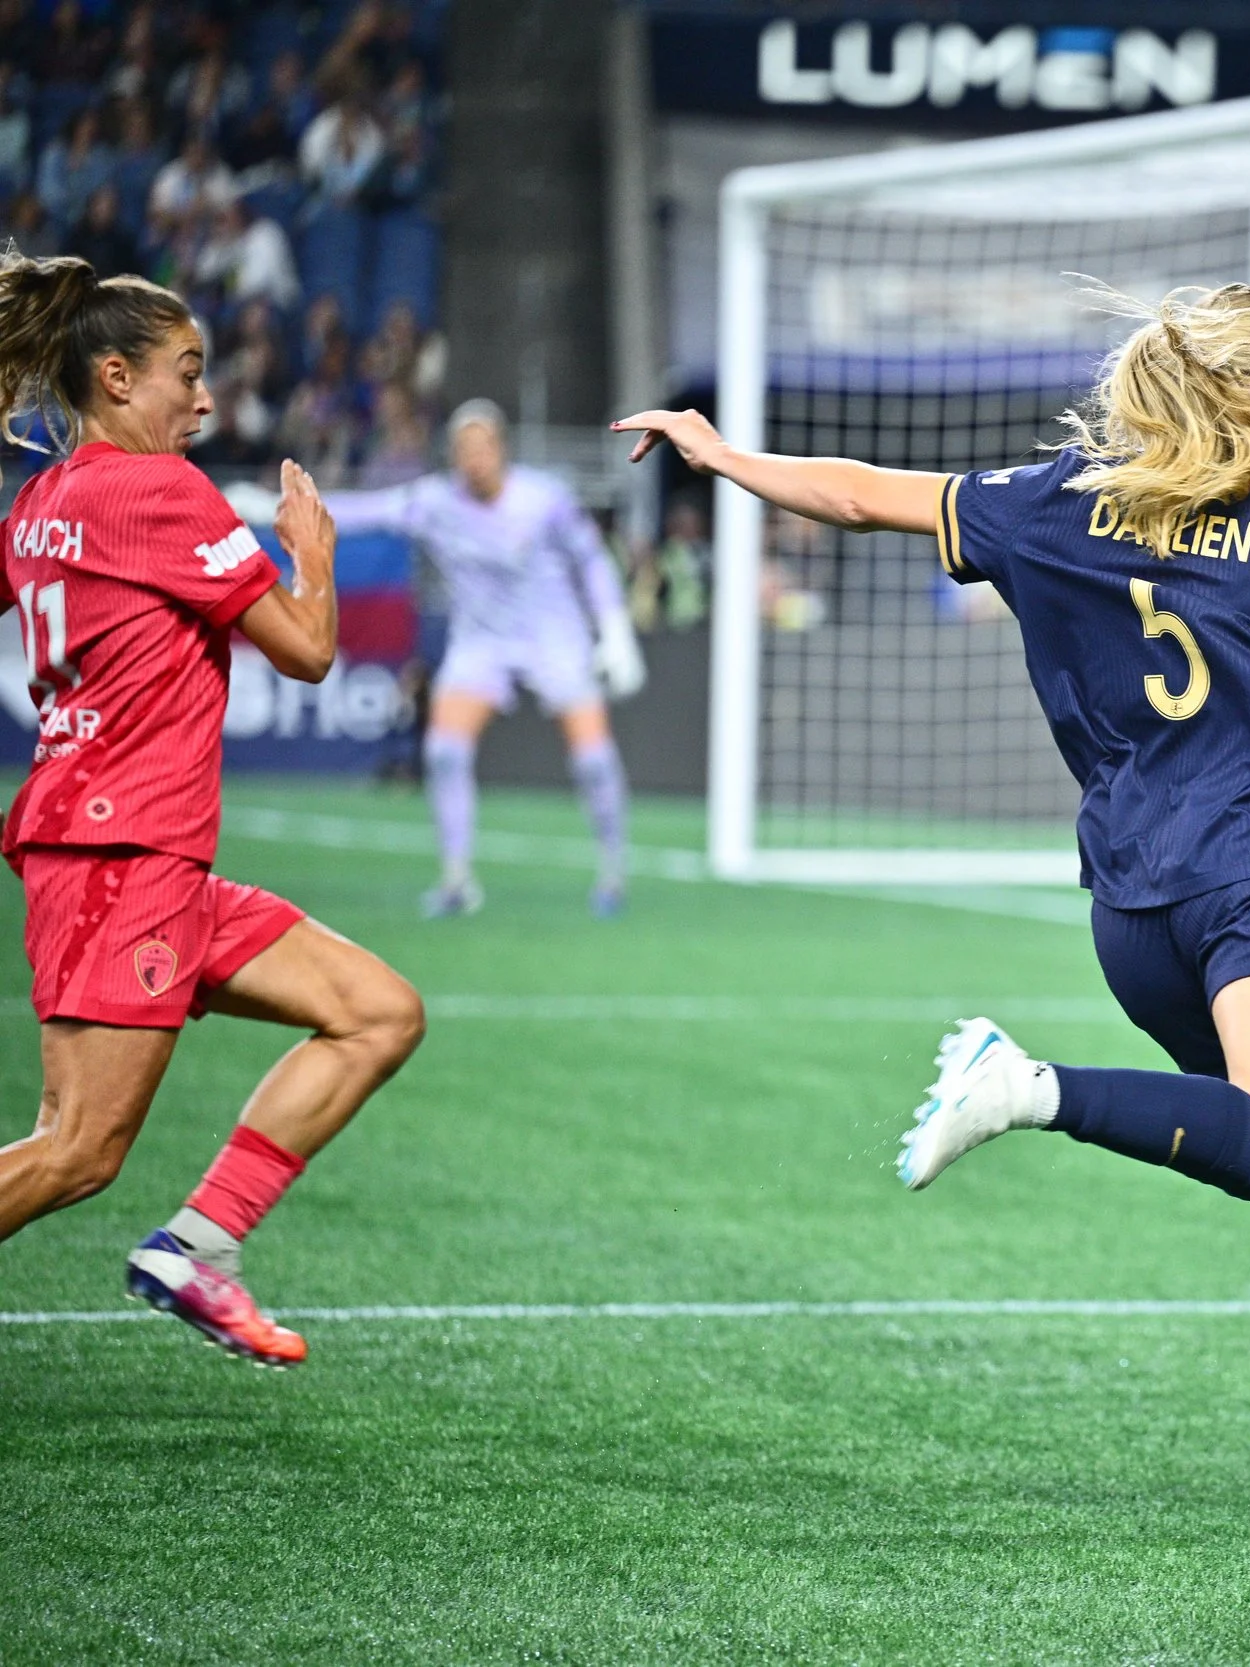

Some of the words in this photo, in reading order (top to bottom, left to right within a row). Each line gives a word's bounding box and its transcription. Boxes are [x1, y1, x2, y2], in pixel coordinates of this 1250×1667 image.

[758, 19, 1217, 109] LUMEN
[13, 518, 83, 561] RAUCH
[19, 580, 82, 714] 11
[1129, 577, 1211, 721] 5
